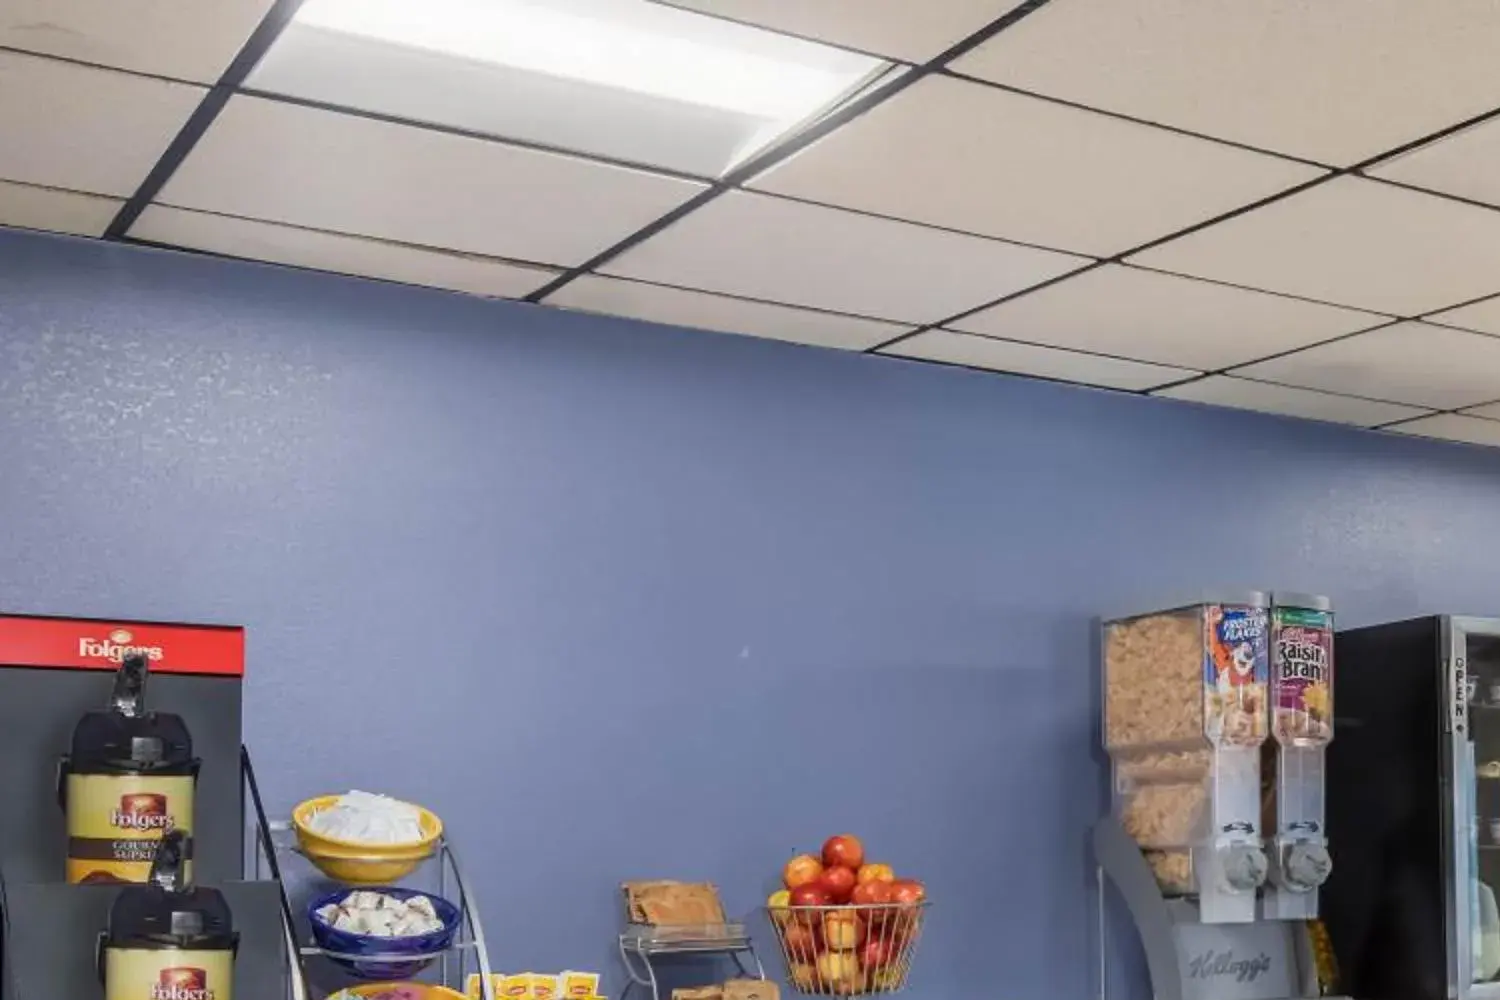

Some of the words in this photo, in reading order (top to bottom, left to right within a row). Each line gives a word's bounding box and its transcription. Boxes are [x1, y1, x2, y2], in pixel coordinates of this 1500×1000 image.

[1224, 627, 1262, 641] FLAKES
[1279, 641, 1326, 664] Raisin
[1283, 659, 1321, 681] Bran
[110, 809, 175, 835] Folgers
